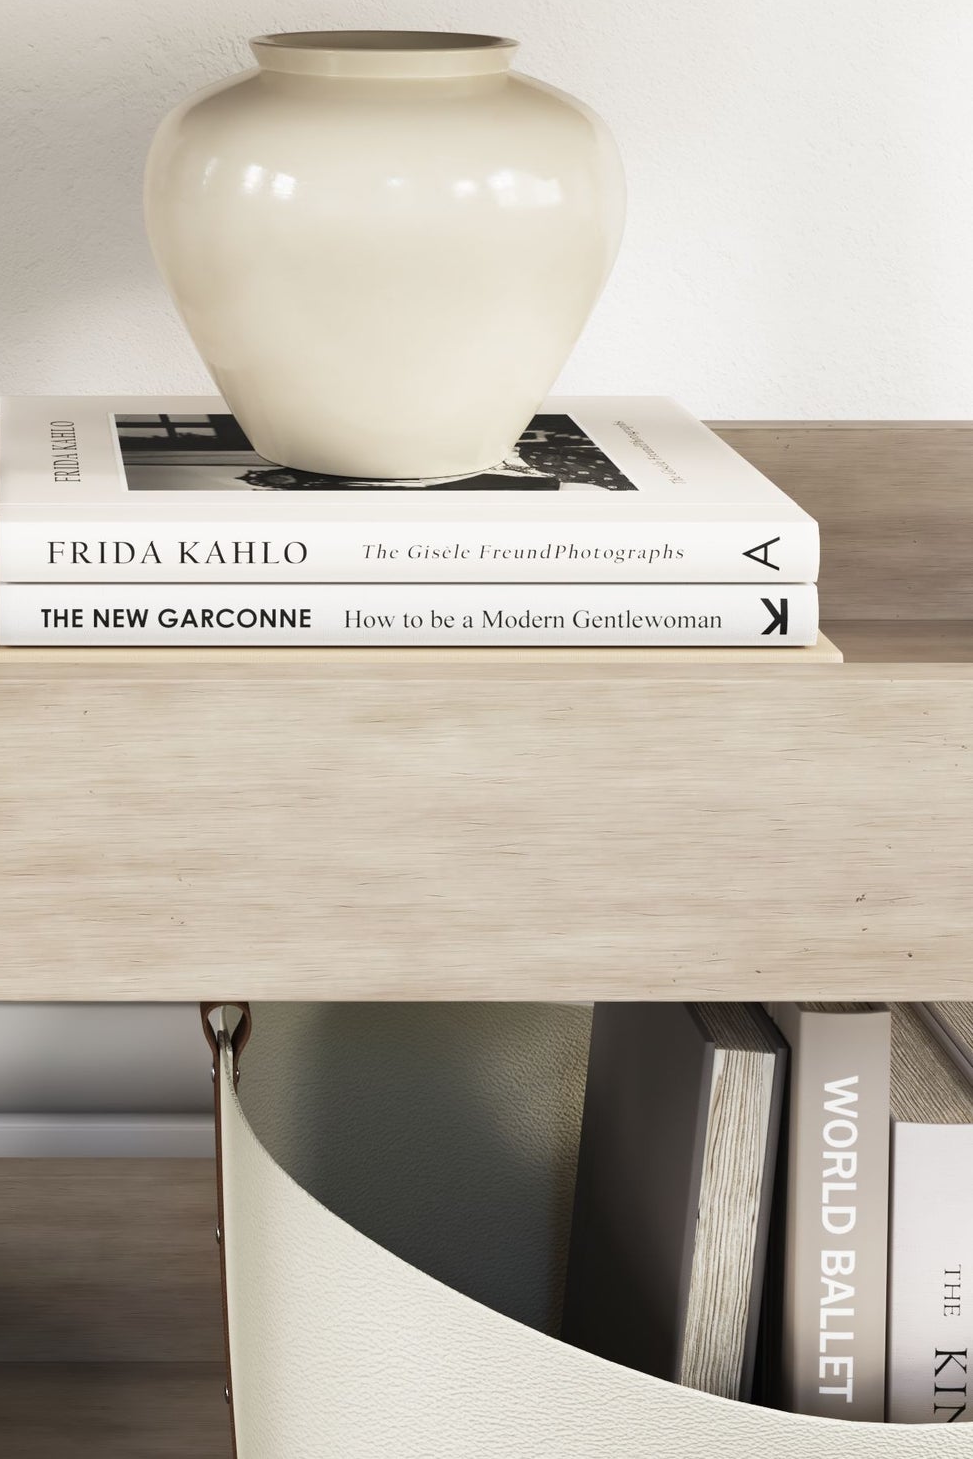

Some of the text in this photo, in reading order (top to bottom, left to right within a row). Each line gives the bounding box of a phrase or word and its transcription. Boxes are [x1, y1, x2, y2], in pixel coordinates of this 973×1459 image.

[50, 420, 81, 482] FRIDA KAHLO
[46, 541, 308, 565] FRIDA KAHLO
[362, 543, 399, 560] The
[742, 536, 781, 572] A
[40, 607, 312, 629] THE NEW GARCONNE
[343, 609, 722, 629] How to be a Modern Gentlewoman
[759, 597, 789, 636] K
[818, 1075, 859, 1404] WORLD BALLET
[943, 1263, 962, 1317] THE
